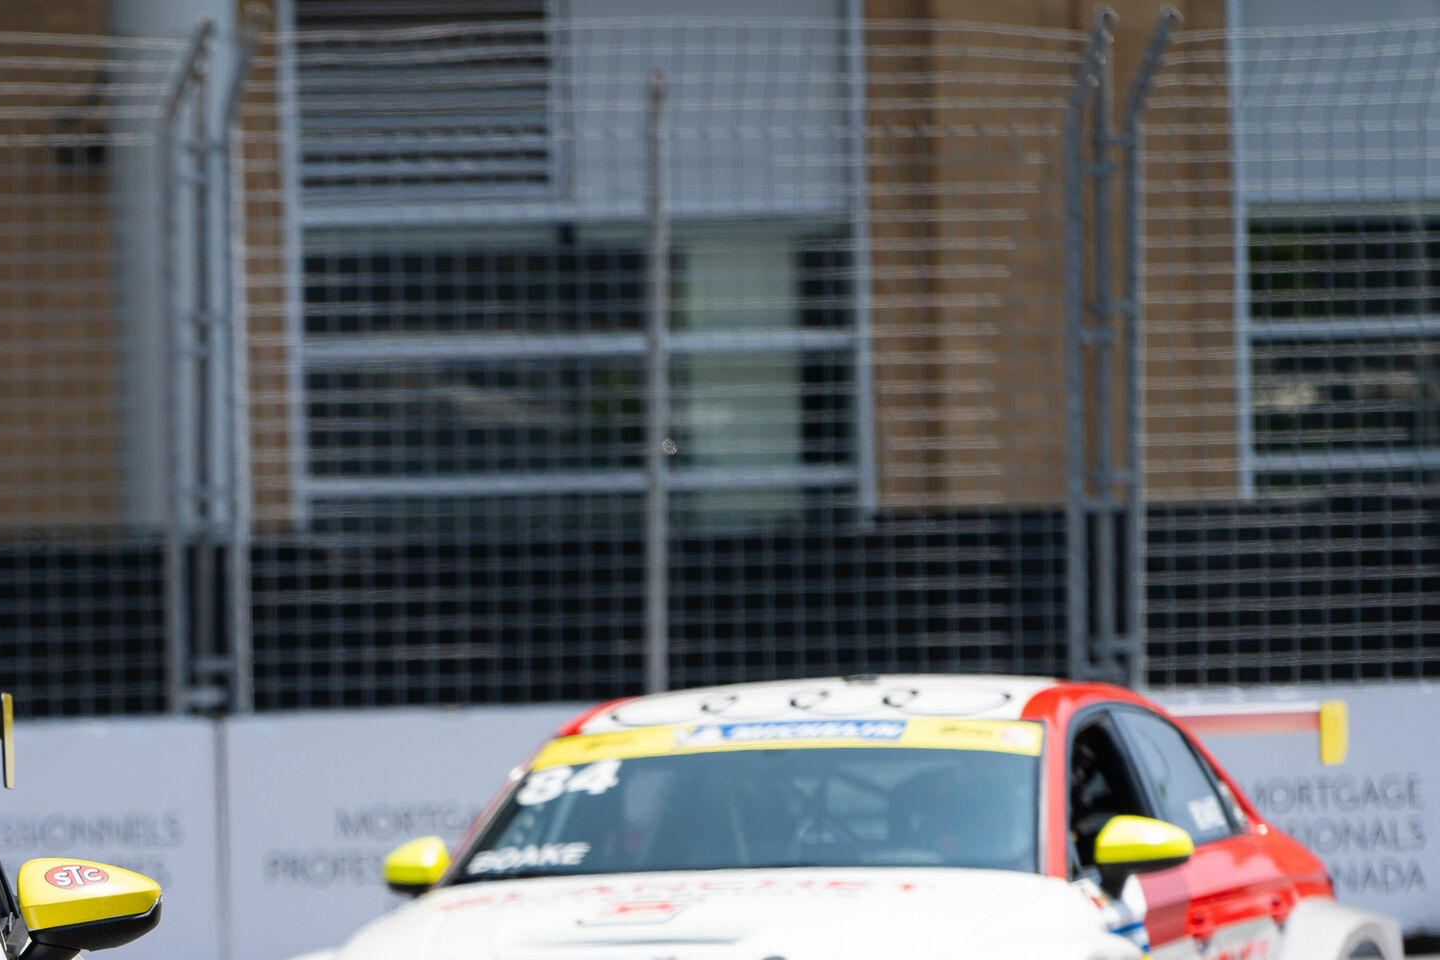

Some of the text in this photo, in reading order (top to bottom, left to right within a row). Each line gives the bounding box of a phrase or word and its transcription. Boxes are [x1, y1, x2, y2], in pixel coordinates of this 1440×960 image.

[516, 758, 622, 806] 84
[467, 842, 591, 874] BOAKE
[53, 866, 104, 886] STC
